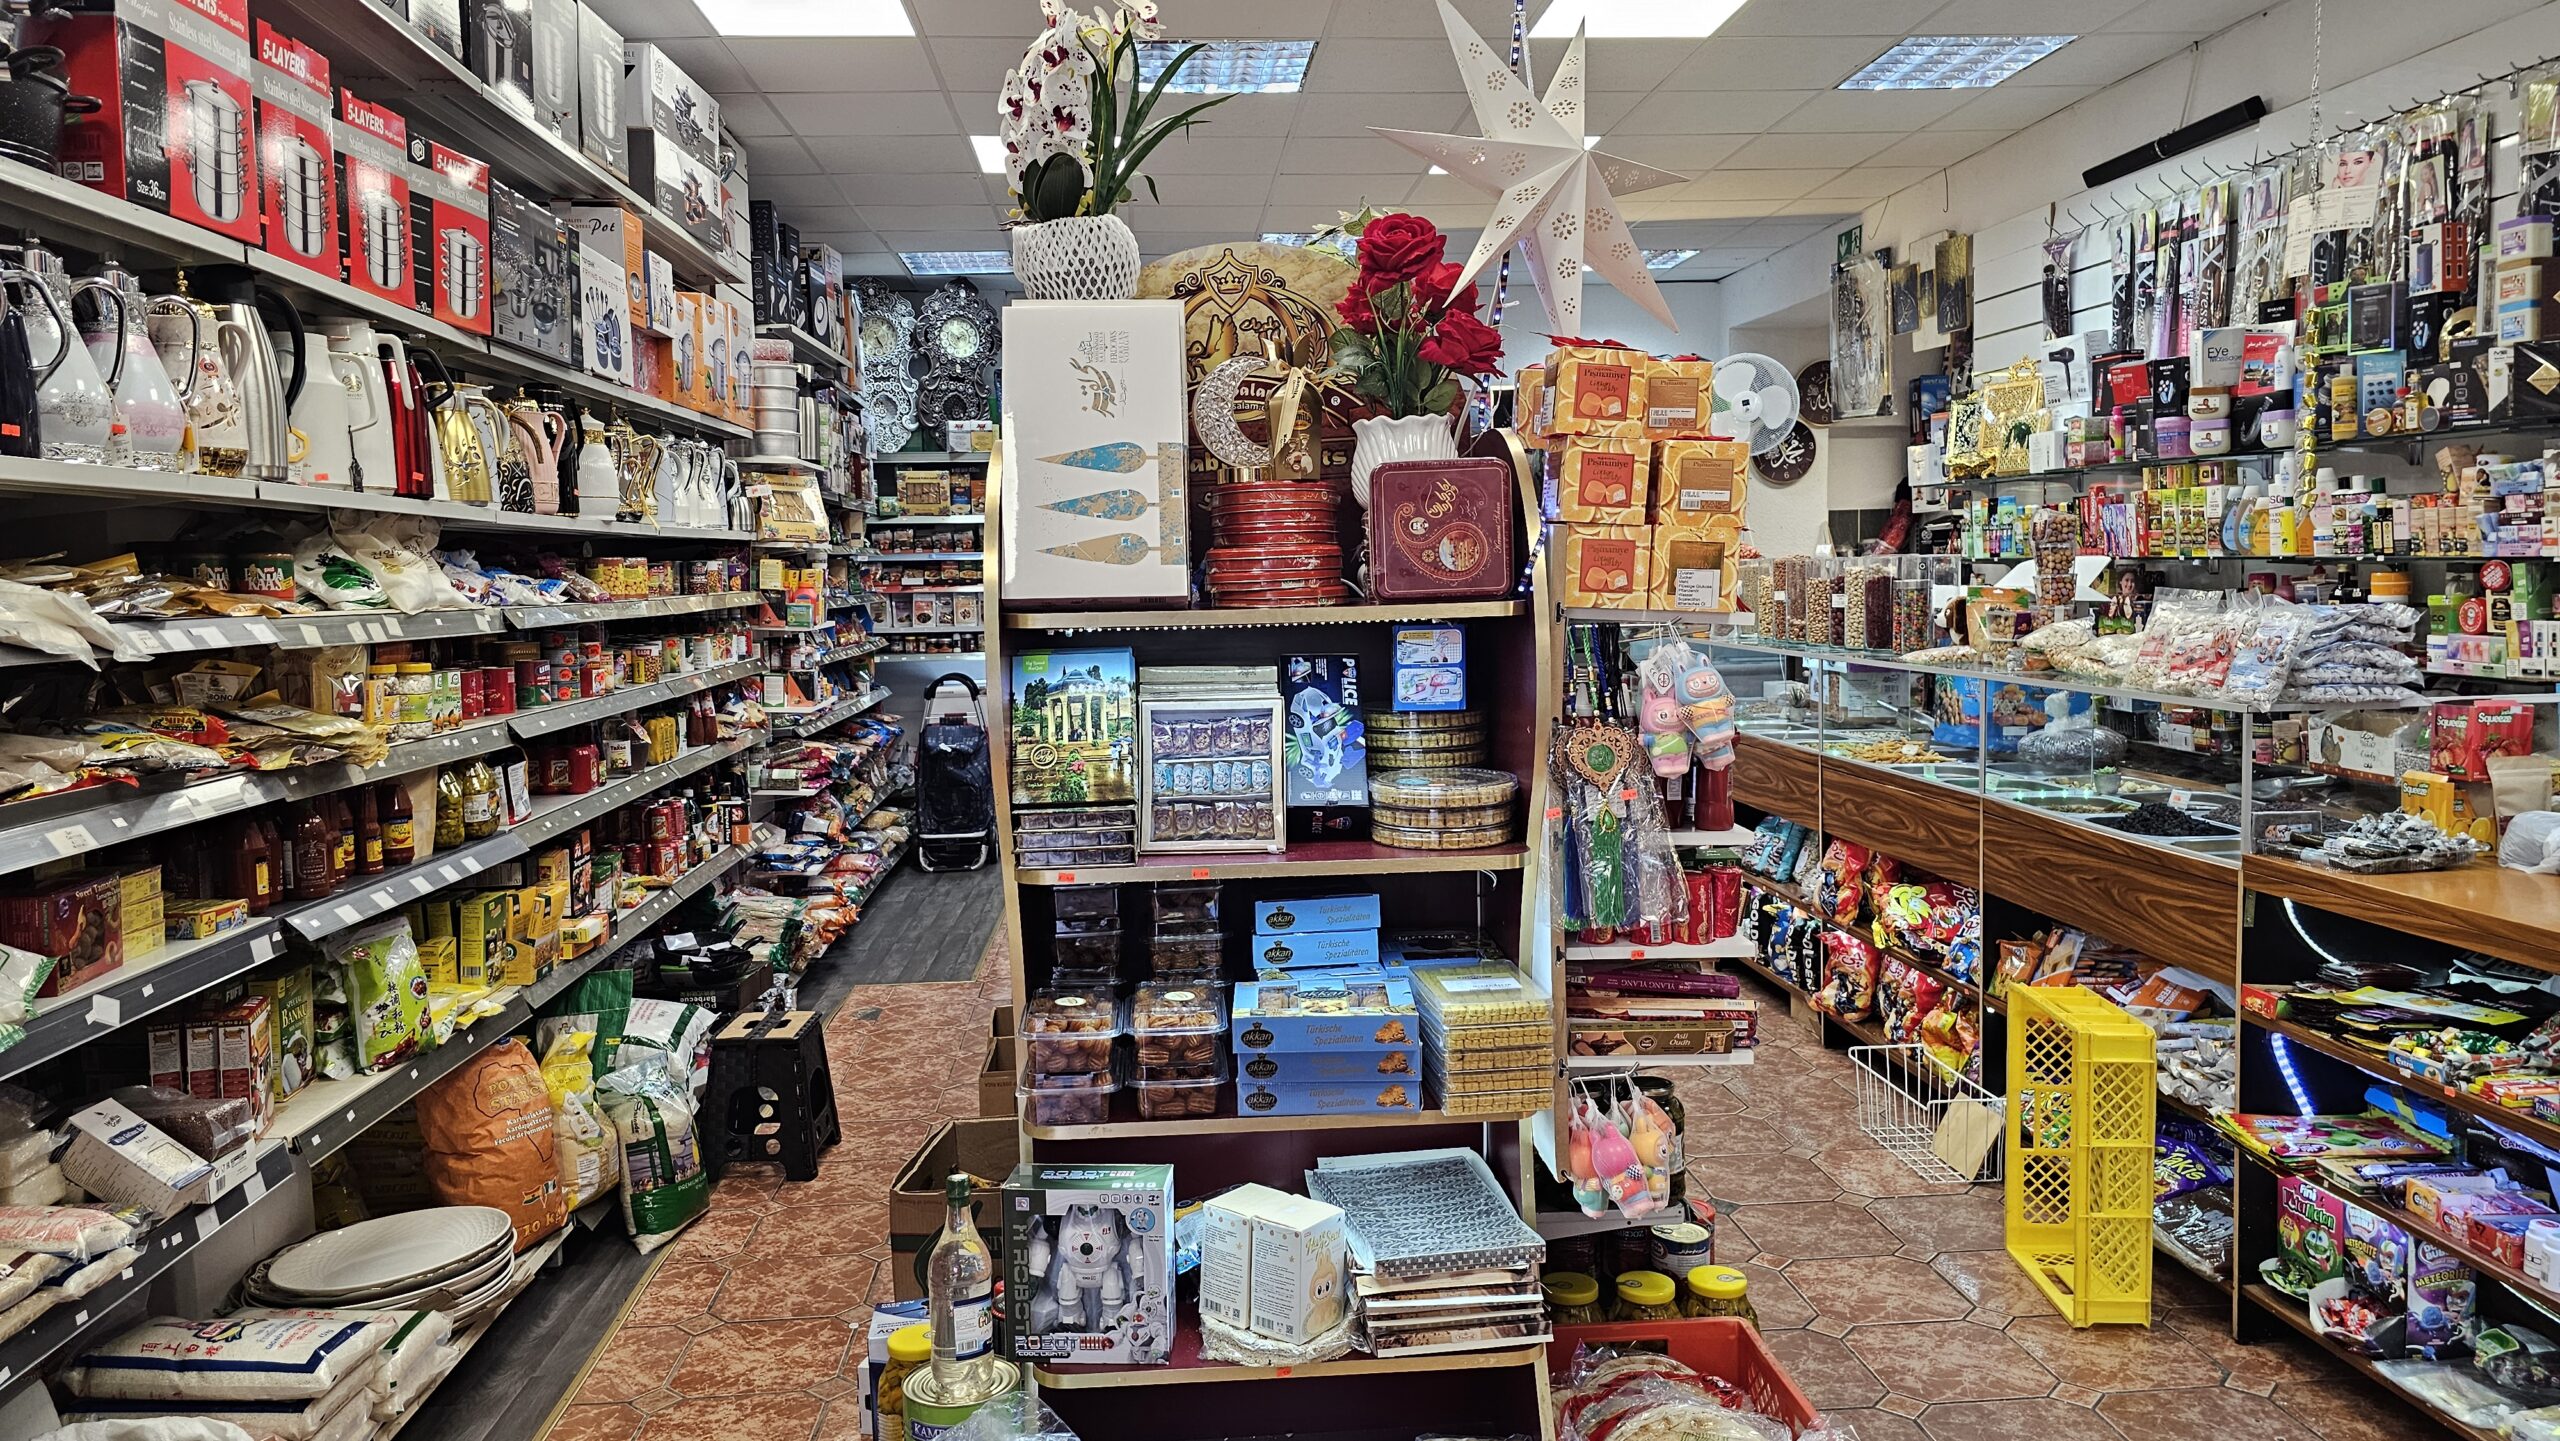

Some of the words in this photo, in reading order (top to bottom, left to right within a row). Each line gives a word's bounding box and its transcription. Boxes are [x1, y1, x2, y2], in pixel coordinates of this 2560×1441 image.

[262, 38, 306, 79] 5-LAYERS
[347, 103, 384, 135] 5-LAYERS
[589, 217, 615, 236] Pot
[2208, 347, 2229, 358] Eye
[1584, 368, 1626, 380] Pismaniye
[1809, 442, 1815, 450] 3
[1587, 457, 1629, 469] Pismaniye
[2437, 716, 2468, 729] Squeeze
[2478, 713, 2512, 724] Squeeze
[2403, 784, 2429, 796] Squeeze
[1268, 913, 1293, 924] akkan
[1319, 904, 1352, 914] Türkische
[1326, 913, 1371, 925] Spezialitäten
[1266, 949, 1291, 959] akkan
[1317, 939, 1350, 949] Türkische
[1325, 949, 1369, 961] Spezialitäten
[1621, 978, 1649, 989] YLANG
[1649, 982, 1675, 991] YLANG
[225, 984, 244, 1003] FUFU
[1243, 1032, 1272, 1043] akkan
[1305, 1024, 1343, 1035] Türkische
[1313, 1035, 1364, 1047] Spezialitäten
[1669, 1038, 1691, 1046] Oudh
[1247, 1062, 1276, 1073] akkan
[1247, 1095, 1276, 1105] akkan
[2168, 1151, 2207, 1180] Takis
[2345, 1238, 2378, 1259] METEORITE
[2415, 1268, 2471, 1288] METEORITE
[1015, 1335, 1079, 1351] ROBOT
